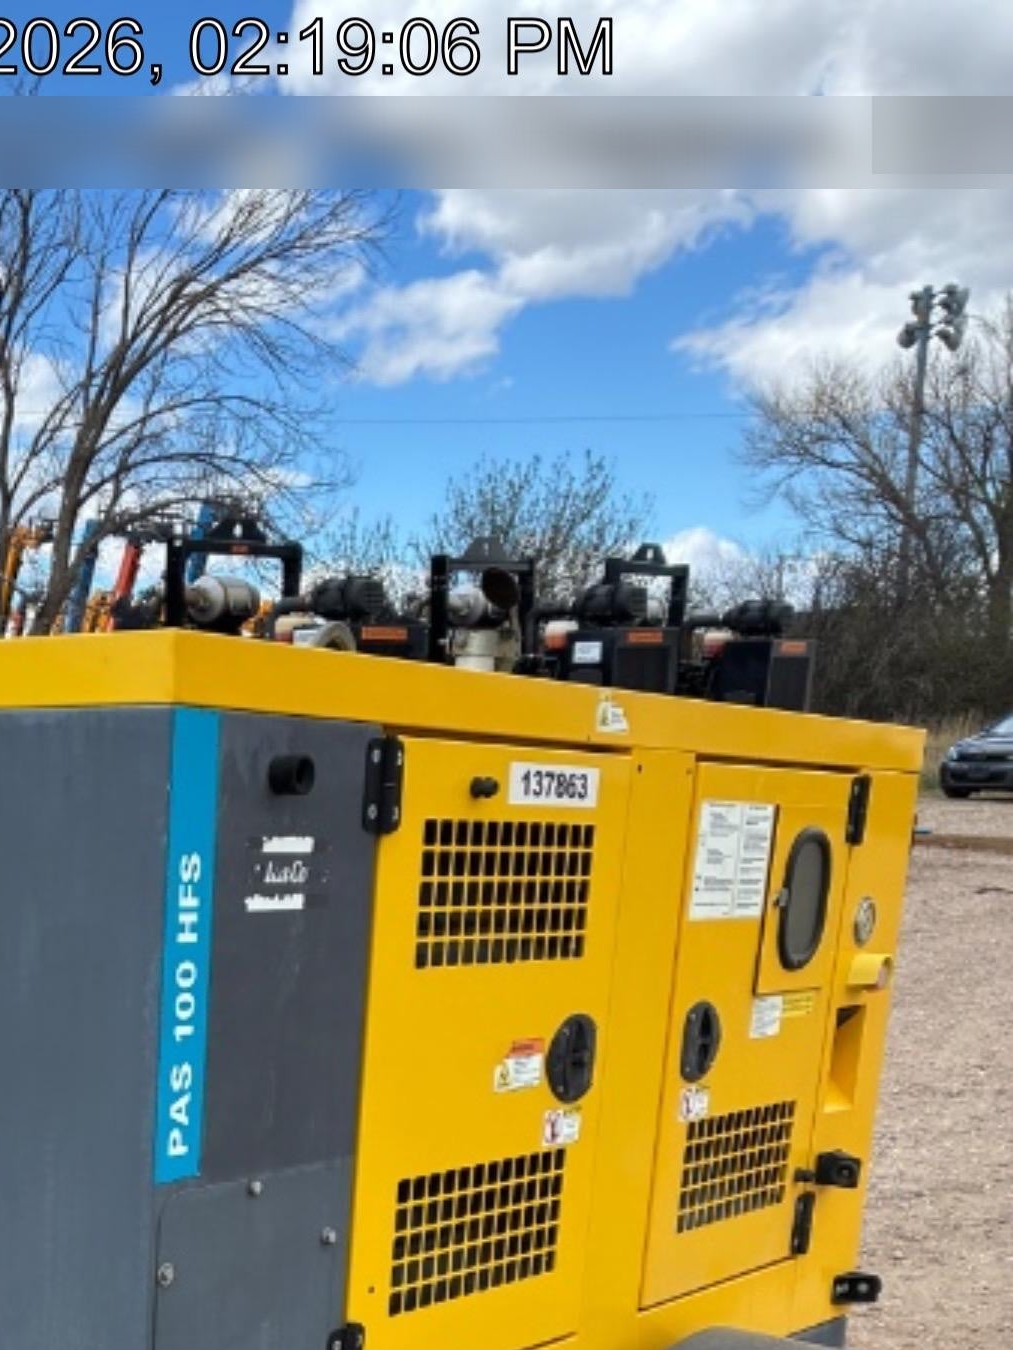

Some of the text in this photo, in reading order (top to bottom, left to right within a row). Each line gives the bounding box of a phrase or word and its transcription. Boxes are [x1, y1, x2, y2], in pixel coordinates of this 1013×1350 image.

[520, 768, 589, 800] 137863
[167, 851, 202, 1157] PAS 100 HFS
